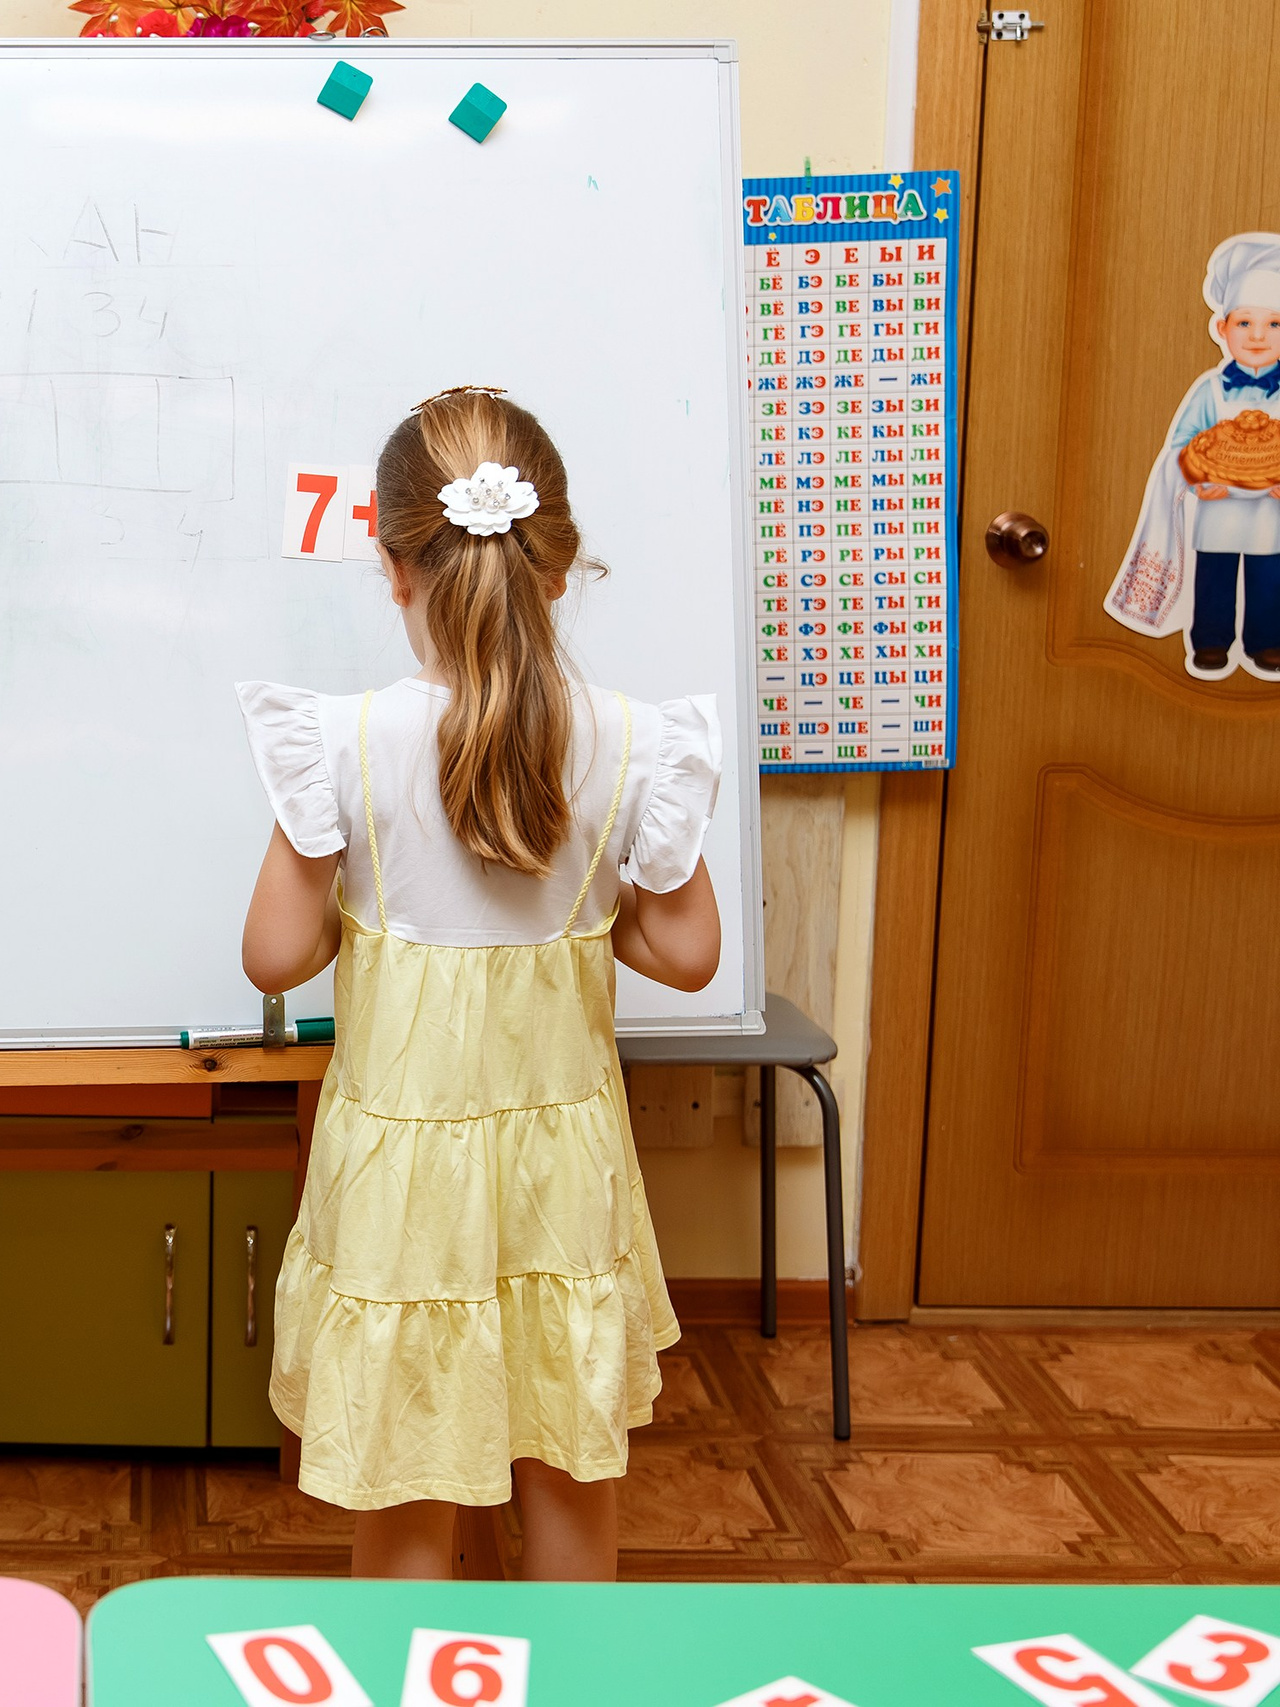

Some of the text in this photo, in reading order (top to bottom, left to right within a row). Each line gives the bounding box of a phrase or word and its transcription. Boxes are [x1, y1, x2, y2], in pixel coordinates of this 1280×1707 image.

[747, 193, 923, 222] ТАБЛИЦА
[805, 247, 821, 265] Э
[844, 247, 859, 264] Е
[879, 246, 902, 263] Ы
[917, 243, 935, 261] И
[798, 274, 823, 289] БЭ
[836, 273, 860, 287] БЕ
[872, 272, 903, 287] БЫ
[914, 270, 941, 285] БИ
[798, 300, 823, 315] ВЭ
[836, 299, 860, 313] ВЕ
[873, 298, 904, 313] ВЫ
[914, 297, 942, 312] ВИ
[800, 324, 824, 339] ГЭ
[838, 323, 862, 338] ГЕ
[874, 322, 904, 337] ГЫ
[914, 321, 939, 336] ГИ
[798, 349, 826, 364] ДЭ
[836, 348, 863, 363] ДЕ
[872, 347, 904, 362] ДЫ
[913, 346, 941, 360] ДИ
[796, 375, 827, 390] ЖЭ
[834, 373, 864, 388] ЖЕ
[911, 371, 942, 386] ЖИ
[799, 400, 826, 415] ЗЭ
[837, 400, 862, 414] ЗЕ
[872, 398, 905, 413] ЗЫ
[912, 398, 940, 413] ЗИ
[798, 426, 825, 440] КЭ
[837, 425, 862, 439] КЕ
[872, 424, 904, 438] КЫ
[912, 422, 940, 437] КИ
[798, 451, 826, 465] ЛЭ
[836, 450, 863, 464] ЛЕ
[872, 448, 904, 463] ЛЫ
[911, 447, 940, 461] ЛИ
[796, 476, 825, 489] МЭ
[835, 474, 862, 489] МЕ
[872, 473, 905, 487] МЫ
[912, 472, 943, 486] МИ
[798, 499, 826, 513] НЭ
[836, 498, 862, 512] НЕ
[872, 497, 904, 512] НЫ
[912, 496, 941, 510] НИ
[799, 523, 826, 538] ПЭ
[837, 522, 862, 537] ПЕ
[873, 521, 905, 536] ПЫ
[913, 520, 940, 534] ПИ
[801, 549, 827, 563] РЭ
[840, 548, 864, 562] РЕ
[874, 547, 905, 560] РЫ
[914, 546, 941, 560] РИ
[800, 573, 827, 588] СЭ
[839, 573, 864, 587] СЕ
[874, 571, 906, 586] СЫ
[914, 570, 942, 585] СИ
[800, 597, 827, 612] ТЭ
[840, 596, 864, 611] ТЕ
[875, 595, 905, 610] ТЫ
[914, 595, 941, 609] ТИ
[798, 622, 827, 636] ФЭ
[837, 621, 864, 635] ФЕ
[873, 620, 906, 635] ФЫ
[913, 619, 943, 634] ФИ
[802, 647, 828, 661] ХЭ
[840, 646, 864, 660] ХЕ
[876, 644, 907, 659] ХЫ
[915, 644, 942, 658] ХИ
[839, 696, 864, 710] ЧЕ
[914, 694, 942, 708] ЧИ
[798, 722, 830, 735] ШЭ
[838, 721, 868, 734] ШЕ
[913, 719, 943, 733] ШИ
[243, 1636, 333, 1705] 0
[1165, 1631, 1270, 1692] 3
[430, 1639, 503, 1707] 6
